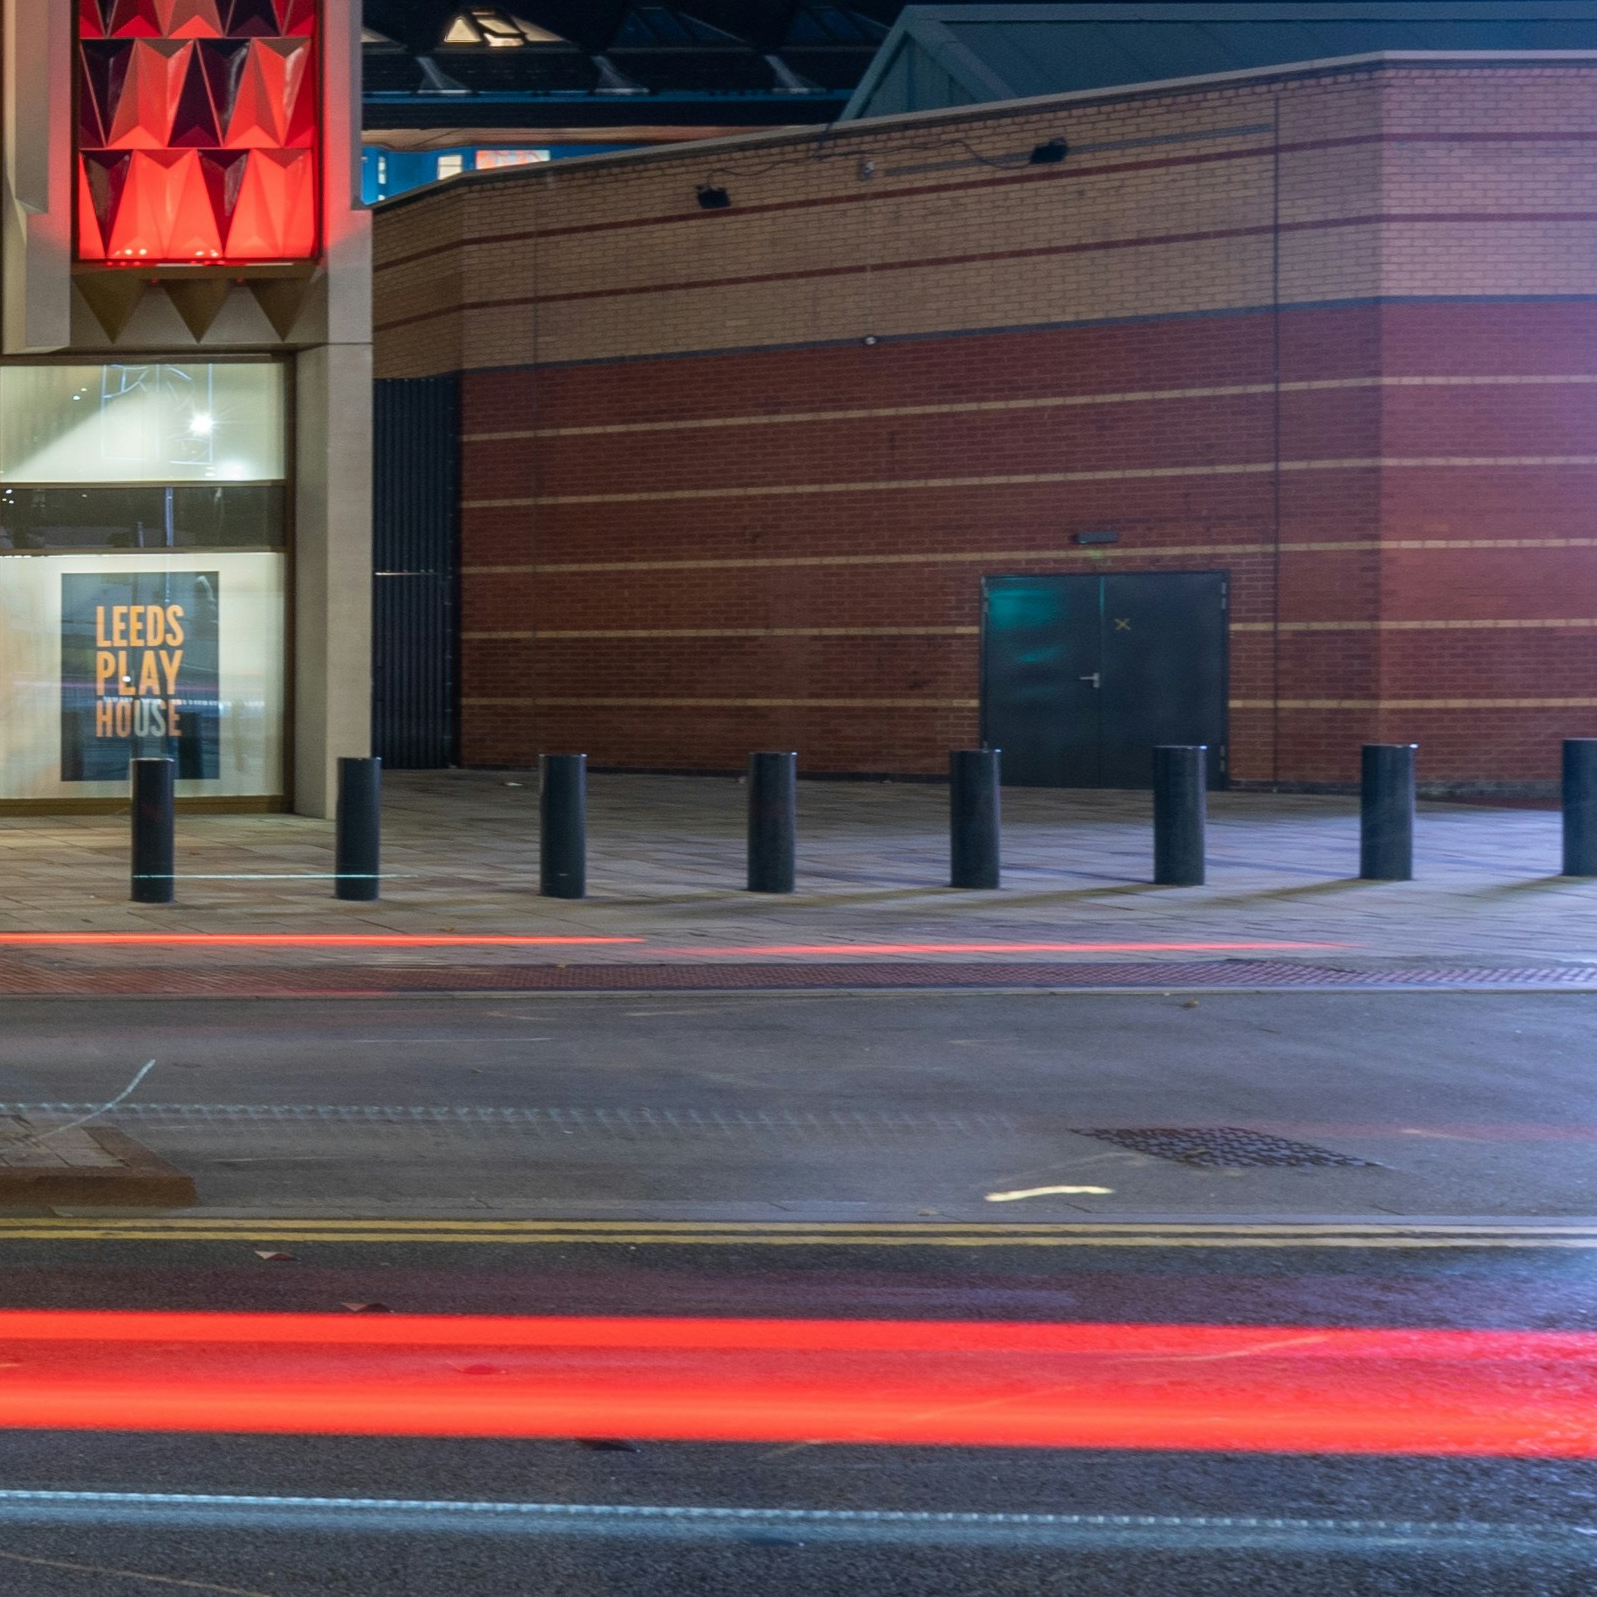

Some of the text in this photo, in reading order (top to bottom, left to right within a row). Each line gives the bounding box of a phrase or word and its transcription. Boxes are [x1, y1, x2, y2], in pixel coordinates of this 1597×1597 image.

[96, 604, 185, 648] LEEDS
[96, 649, 184, 696] PLAY
[96, 698, 183, 738] HOUSE
